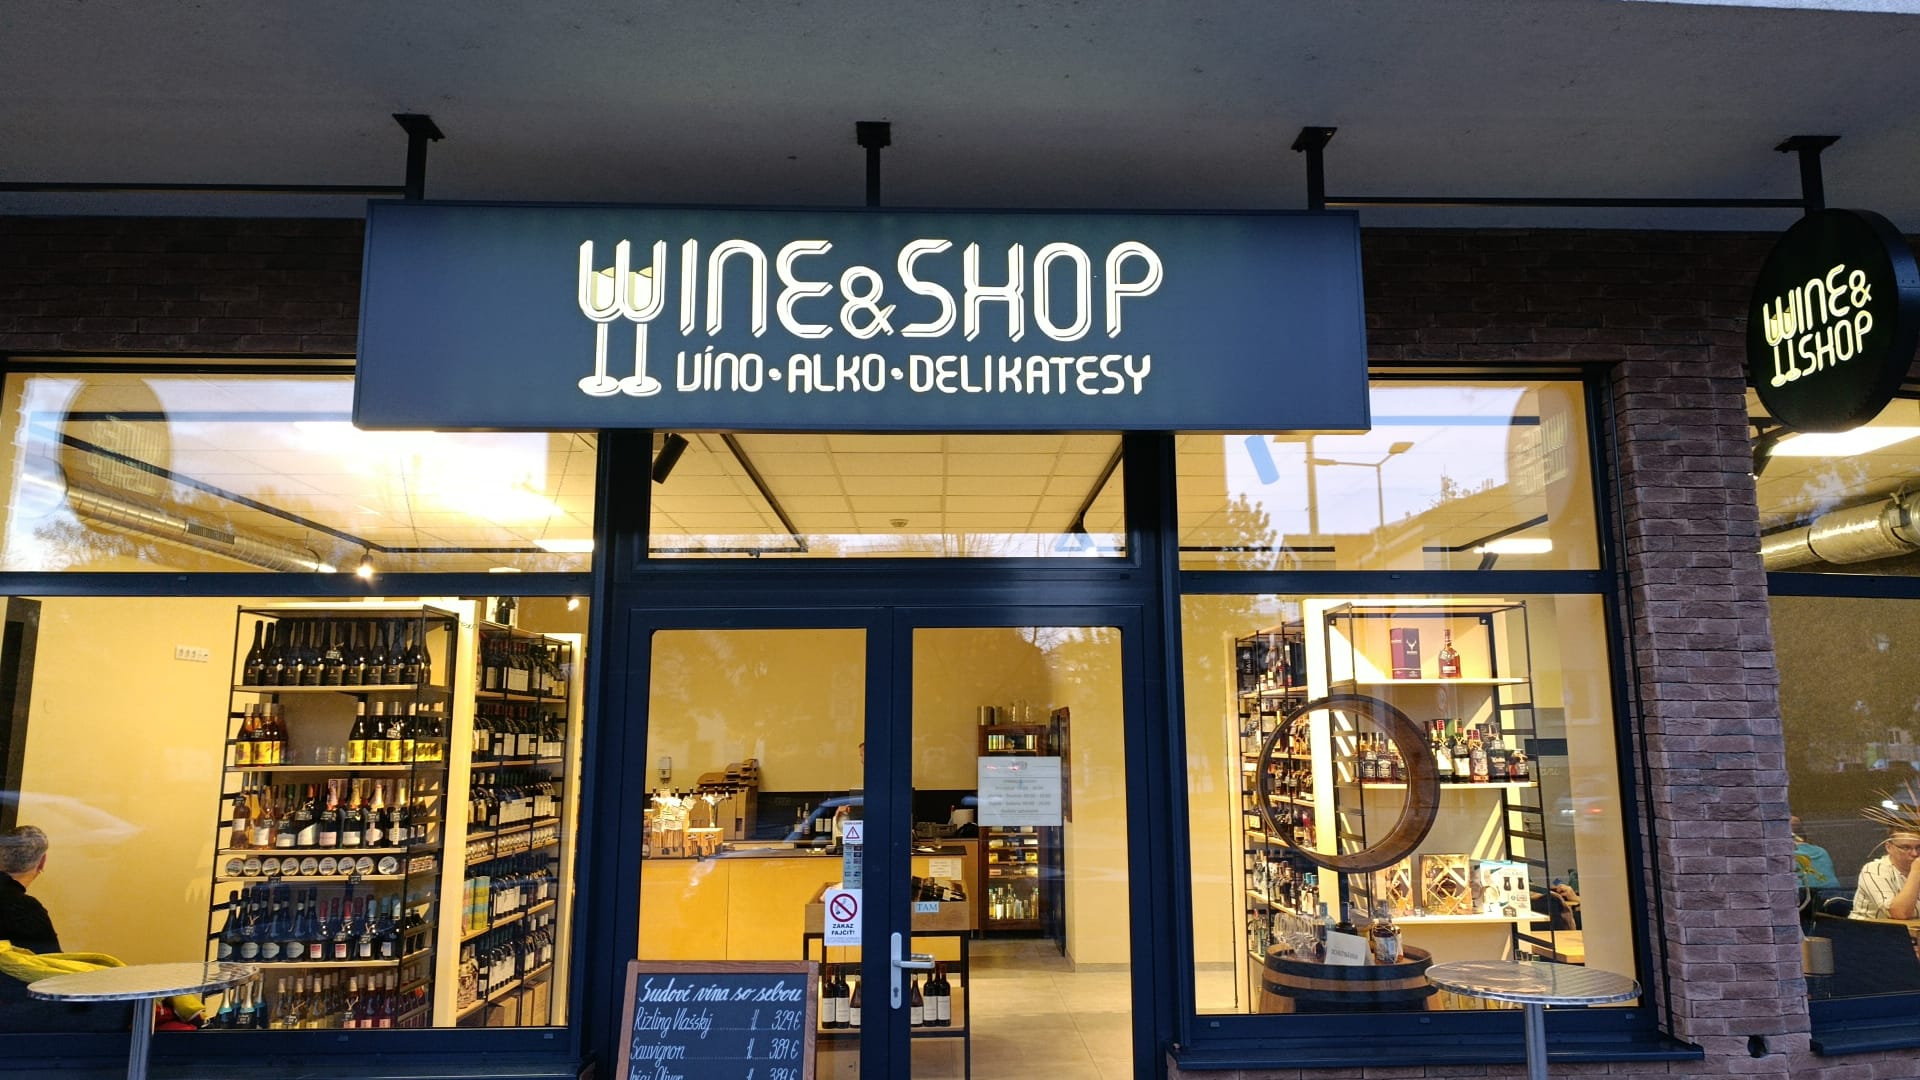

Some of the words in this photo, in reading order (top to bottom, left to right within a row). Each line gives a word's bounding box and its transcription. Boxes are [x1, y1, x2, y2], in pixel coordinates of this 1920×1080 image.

[1798, 309, 1873, 377] SHOP
[908, 354, 1153, 396] DELIKATESY
[729, 986, 757, 1003] so
[751, 980, 804, 1003] sebou
[633, 1006, 673, 1039] Rizling
[630, 1037, 686, 1068] Sauvignon
